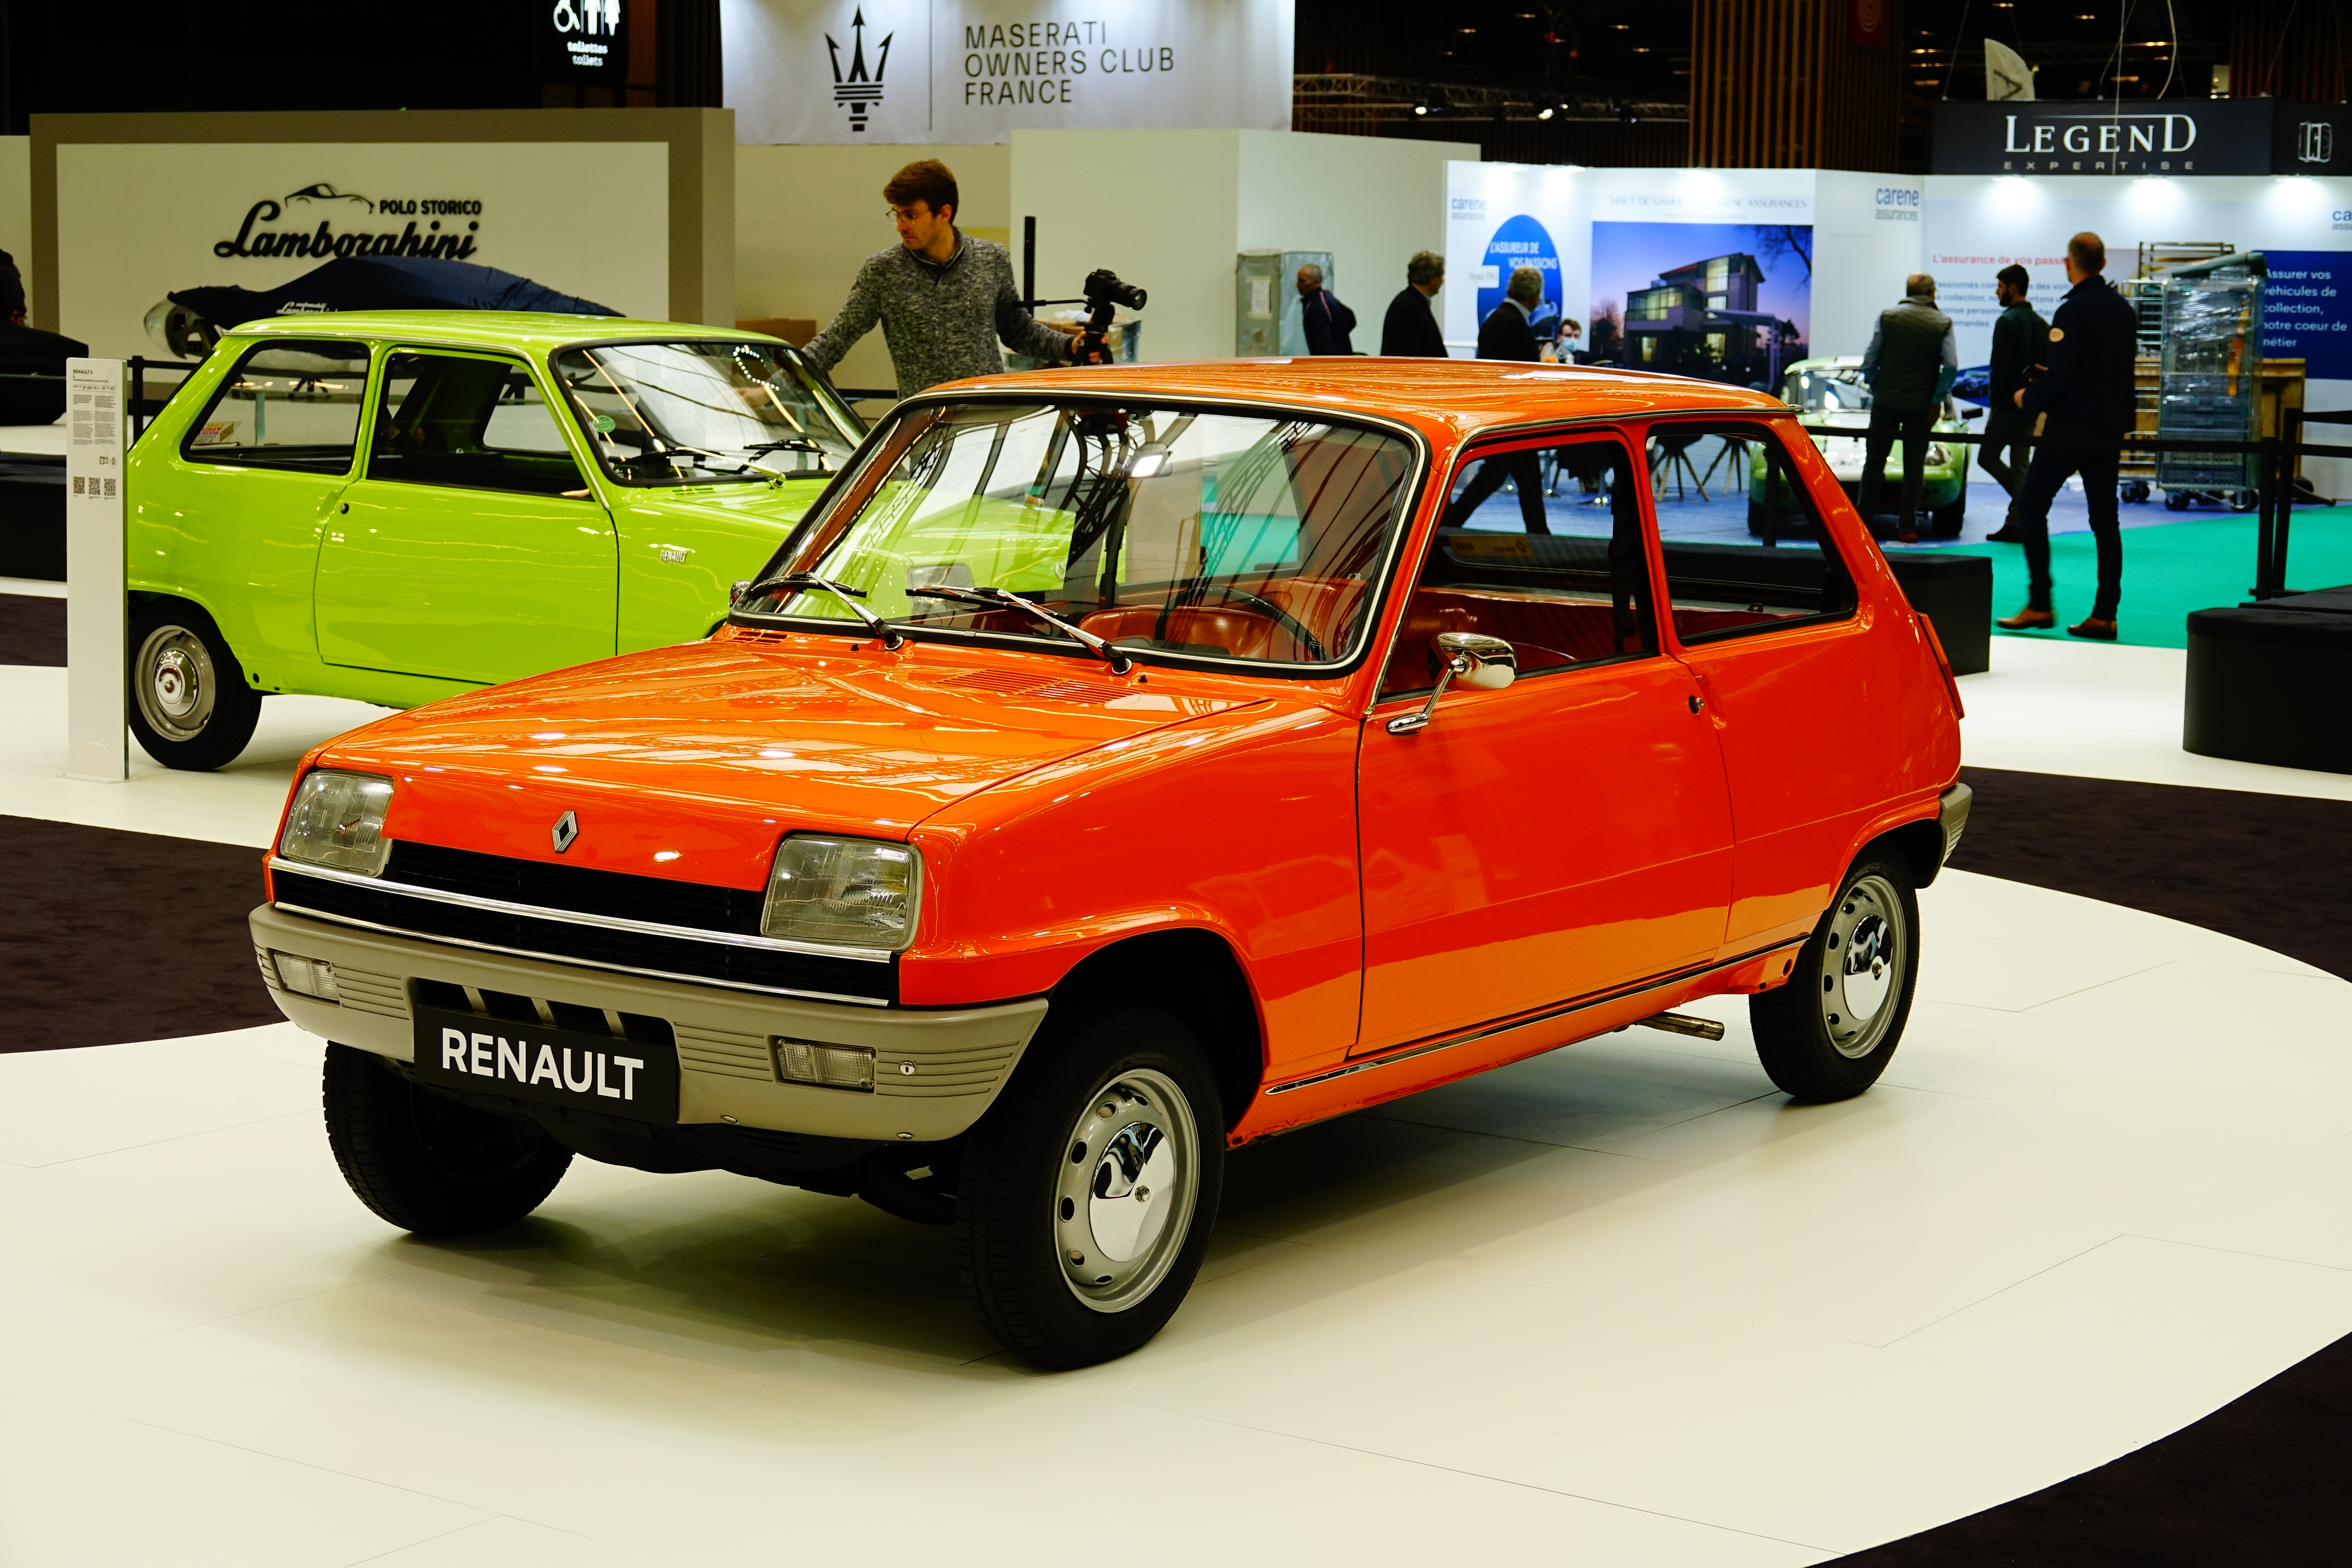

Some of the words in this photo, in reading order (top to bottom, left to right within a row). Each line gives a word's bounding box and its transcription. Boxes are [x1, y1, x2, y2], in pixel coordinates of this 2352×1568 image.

[965, 21, 1106, 49] MASERATI
[567, 40, 608, 54] toilettes
[572, 54, 603, 67] toilets
[965, 50, 1087, 77] OWNERS
[1100, 47, 1174, 73] CLUB
[965, 79, 1073, 105] FRANCE
[2004, 114, 2197, 153] LEGEND
[2003, 161, 2194, 171] EXPERTISE
[1876, 188, 1919, 206] carene
[380, 199, 416, 214] POLO
[421, 199, 482, 215] STORICO
[1875, 209, 1918, 221] assurances
[2333, 211, 2352, 221] ca
[1489, 241, 1528, 254] L'ASSUREUR
[1530, 242, 1540, 254] DE
[1932, 254, 1995, 263] L'assurance
[1999, 256, 2011, 264] de
[2310, 271, 2331, 279] vos
[2321, 286, 2337, 297] de
[2294, 322, 2329, 331] coeur
[2331, 320, 2348, 331] de
[660, 549, 687, 563] RENAULT
[442, 1027, 644, 1100] RENAULT
